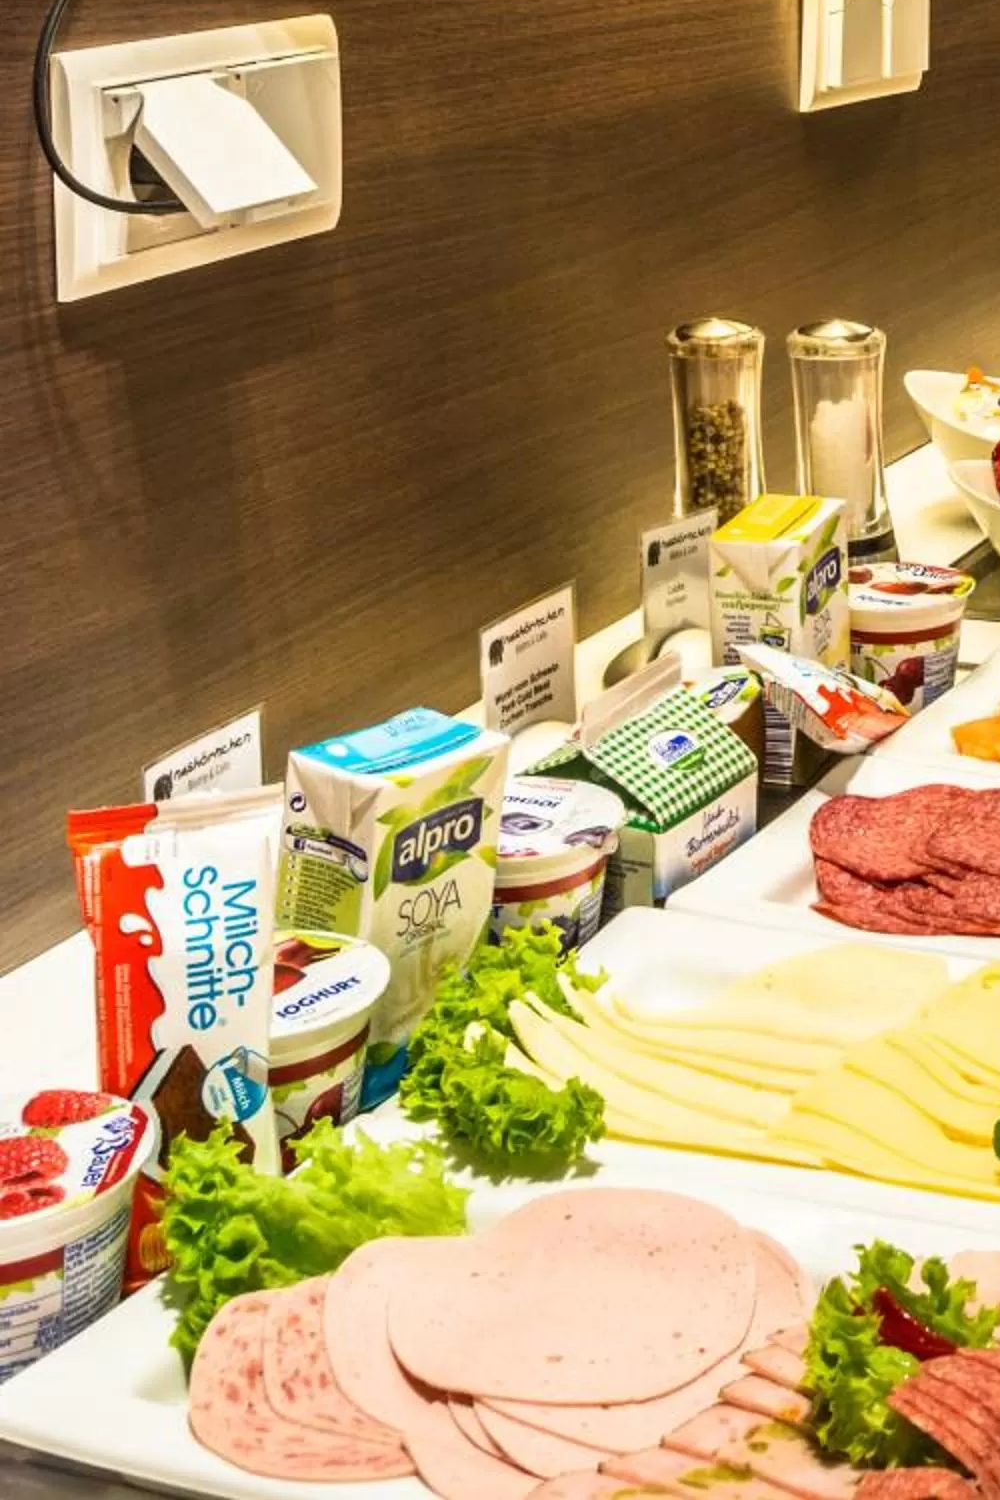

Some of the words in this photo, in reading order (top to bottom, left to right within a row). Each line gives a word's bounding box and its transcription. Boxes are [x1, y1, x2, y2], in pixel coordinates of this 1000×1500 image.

[806, 560, 837, 602] alpro
[398, 811, 475, 868] alpro
[396, 878, 462, 937] SOYA
[183, 865, 225, 1031] Schnitte
[222, 877, 260, 1007] Milch-
[231, 1076, 251, 1111] Milch
